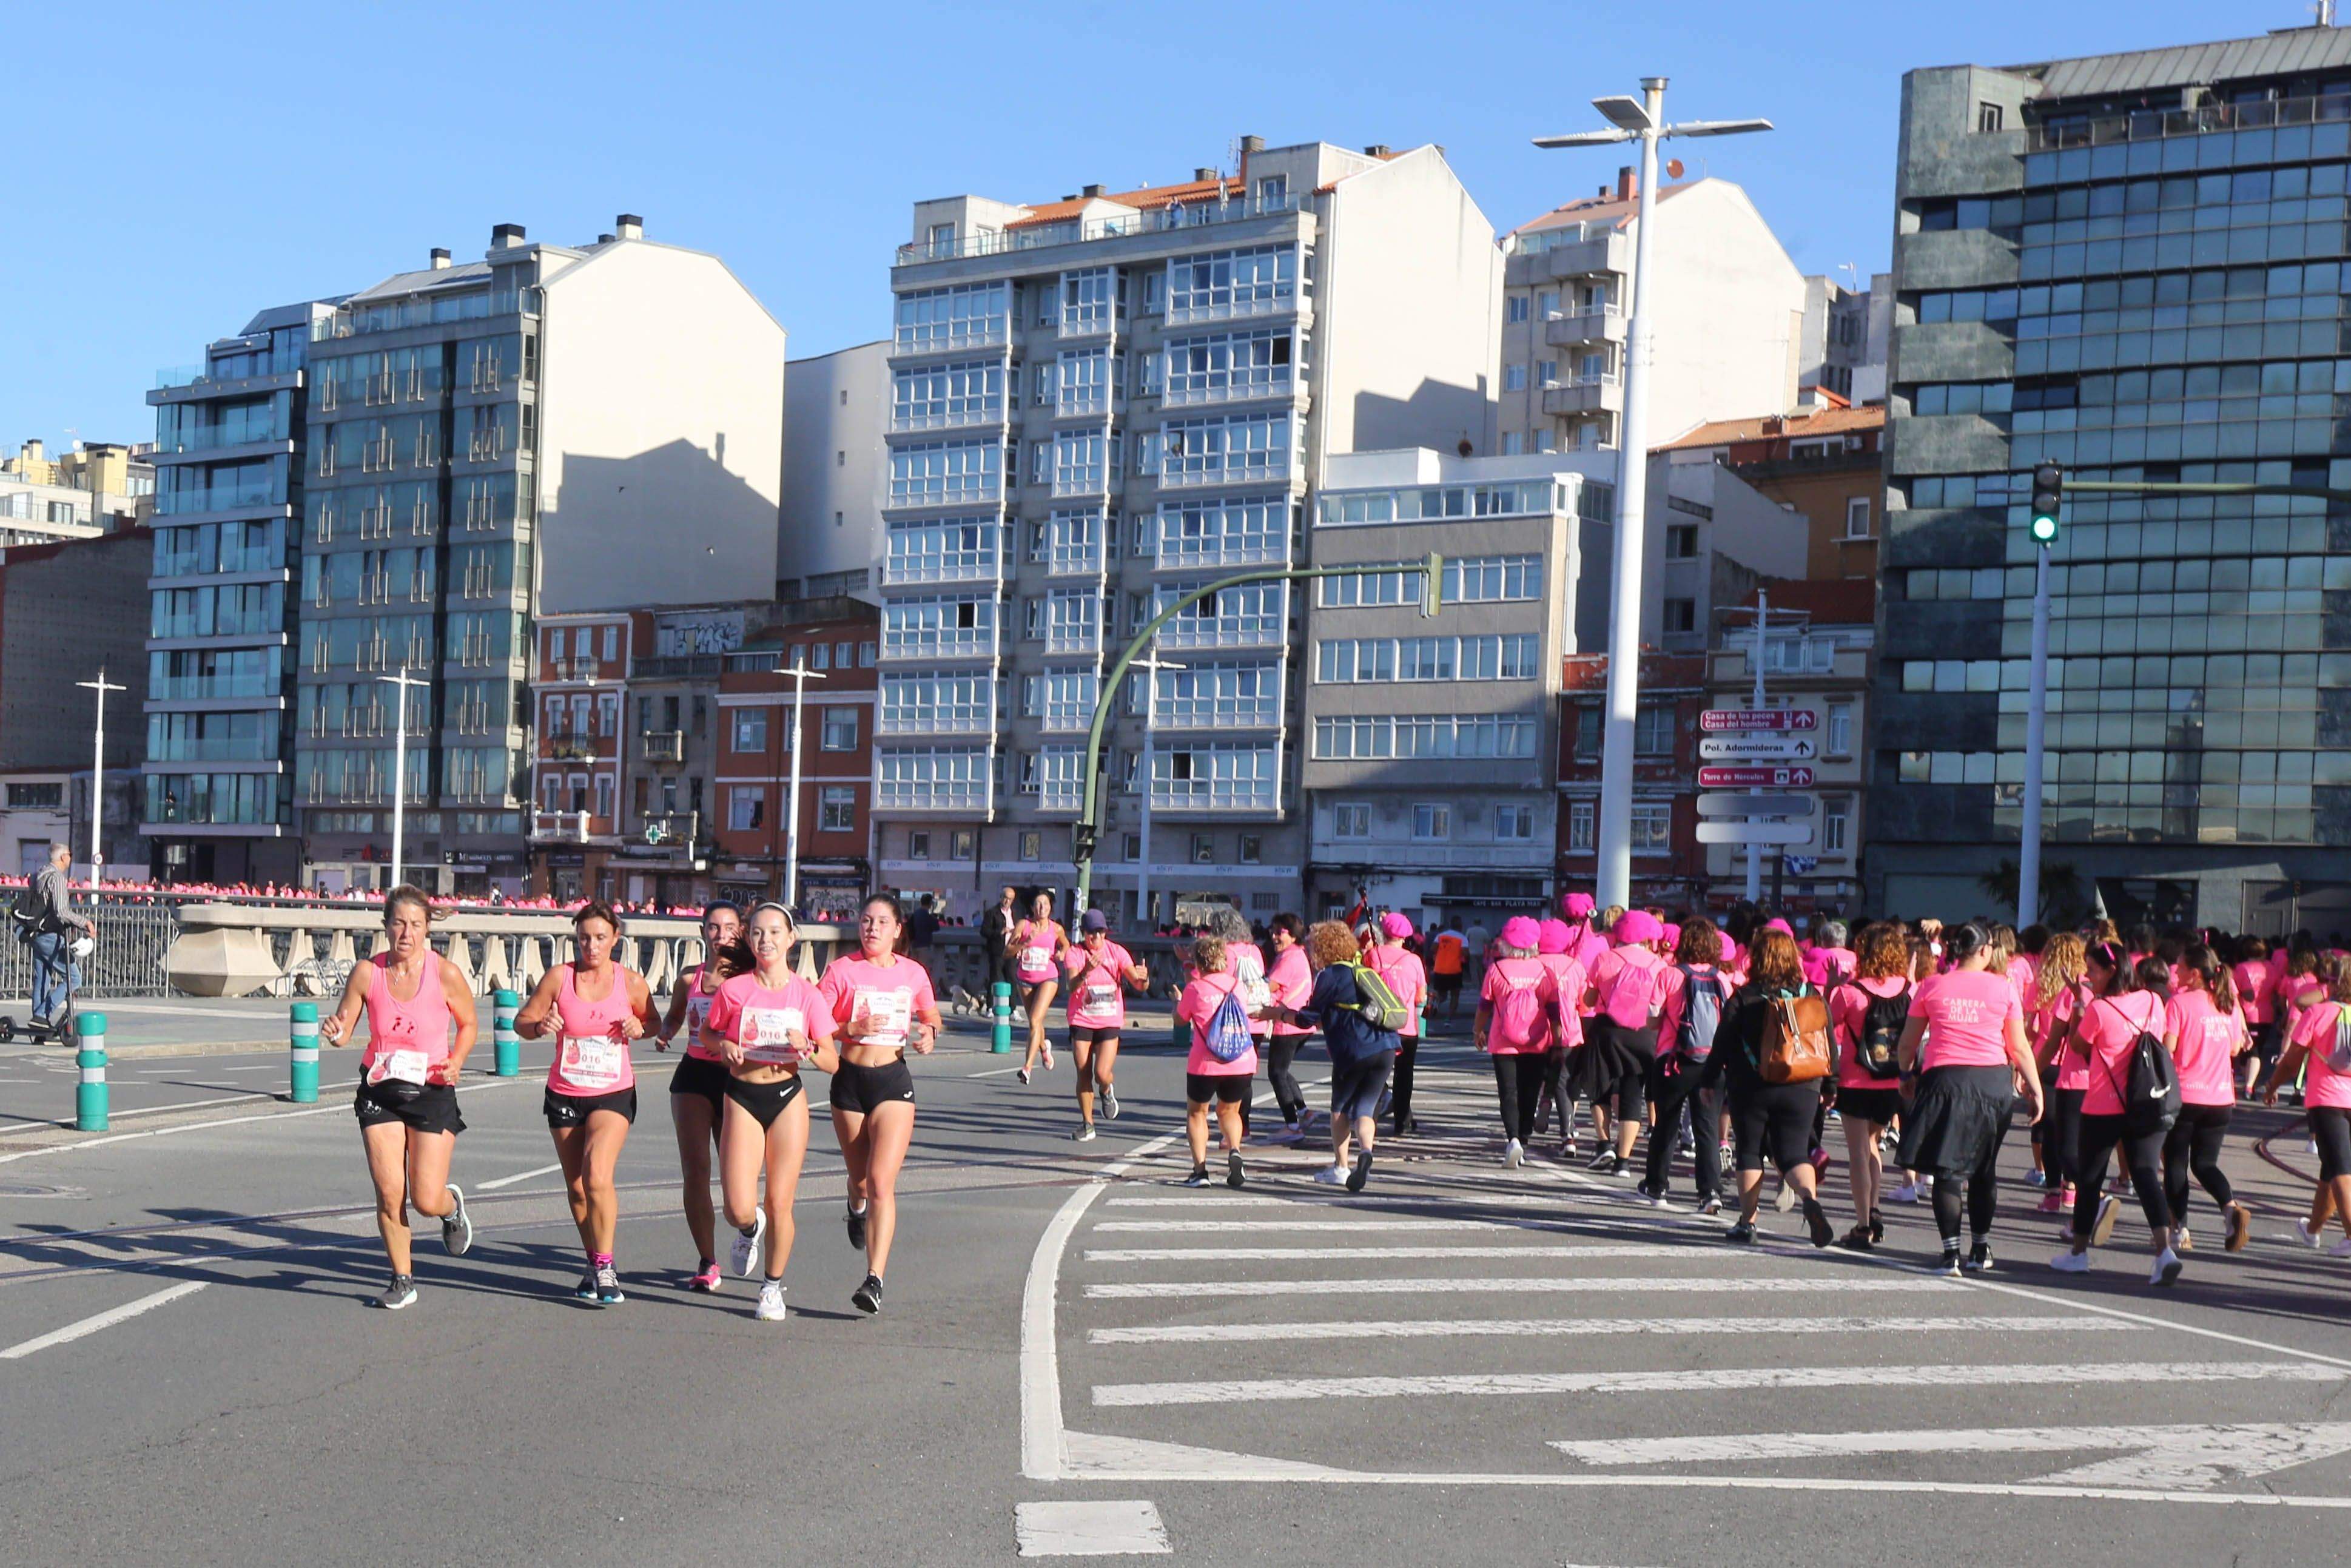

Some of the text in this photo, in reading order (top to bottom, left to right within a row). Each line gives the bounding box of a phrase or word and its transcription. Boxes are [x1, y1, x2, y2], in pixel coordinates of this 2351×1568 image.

[1752, 712, 1775, 721] peces
[1725, 744, 1784, 752] Adormideras
[1942, 998, 1986, 1009] CARRERA
[1951, 1006, 1977, 1015] DE LA
[1948, 1014, 1979, 1024] MUJER
[2199, 1015, 2232, 1025] CARRERA
[761, 1030, 781, 1040] 016
[582, 1054, 600, 1064] 016
